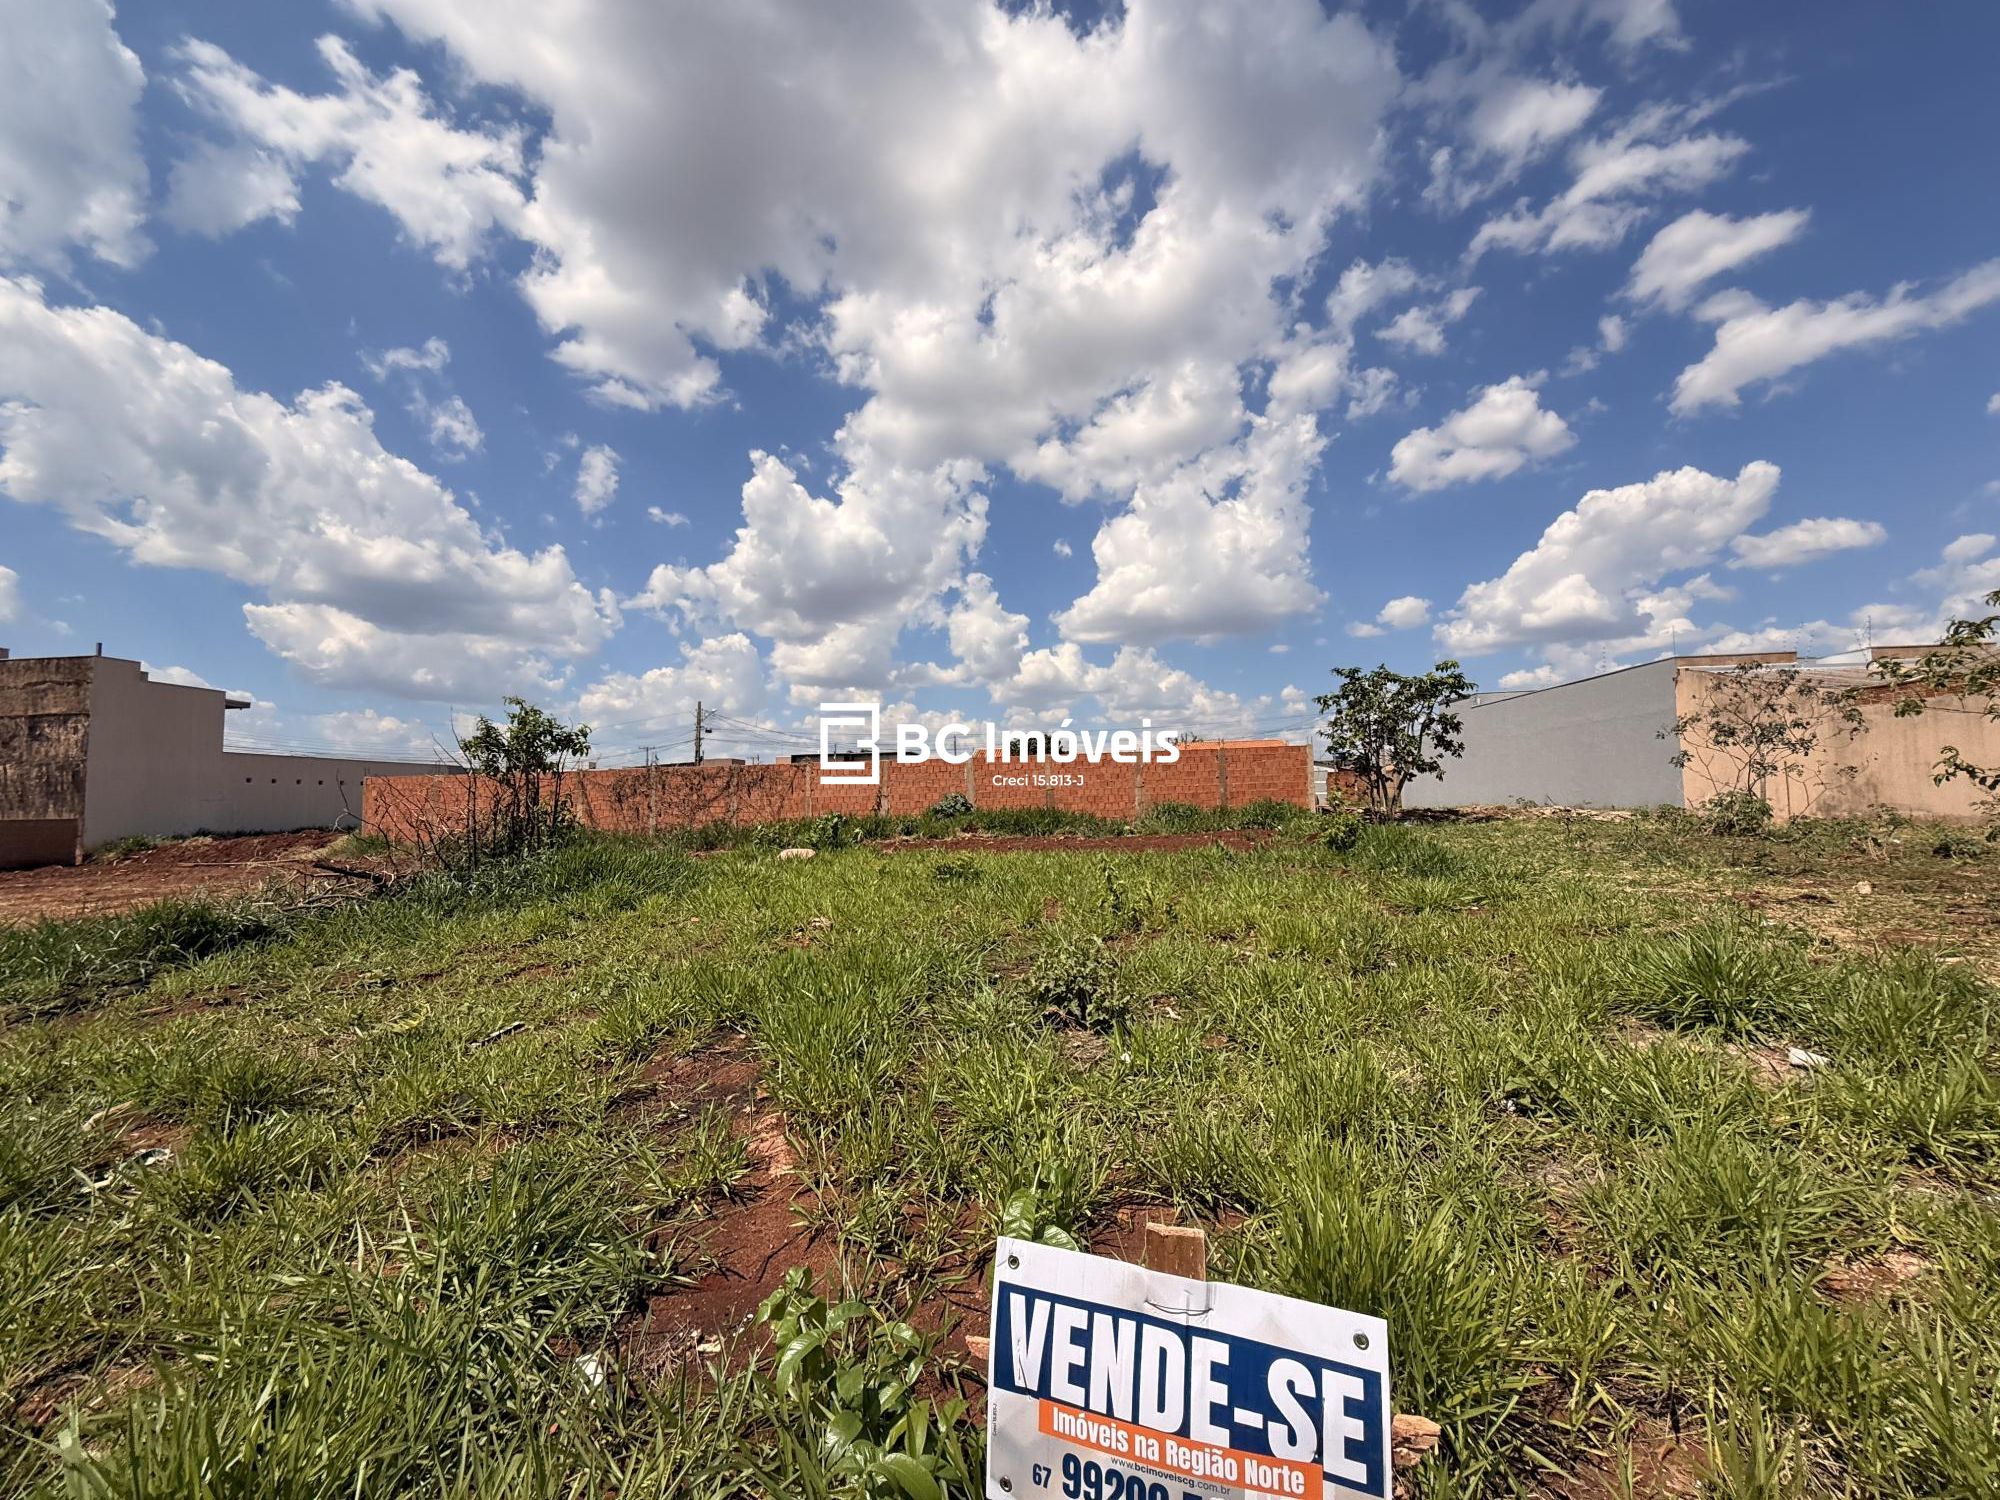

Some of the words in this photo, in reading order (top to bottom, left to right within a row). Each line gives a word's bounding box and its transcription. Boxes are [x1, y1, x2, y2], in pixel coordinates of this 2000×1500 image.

[1009, 1292, 1368, 1485] VENDE-SE
[1032, 1463, 1052, 1489] 67
[1053, 1406, 1129, 1453] Imóveis
[1134, 1434, 1160, 1462] na
[1165, 1439, 1238, 1481] Região
[1244, 1457, 1305, 1495] Norte
[1111, 1456, 1231, 1496] www.bcimoveiscg.com.br
